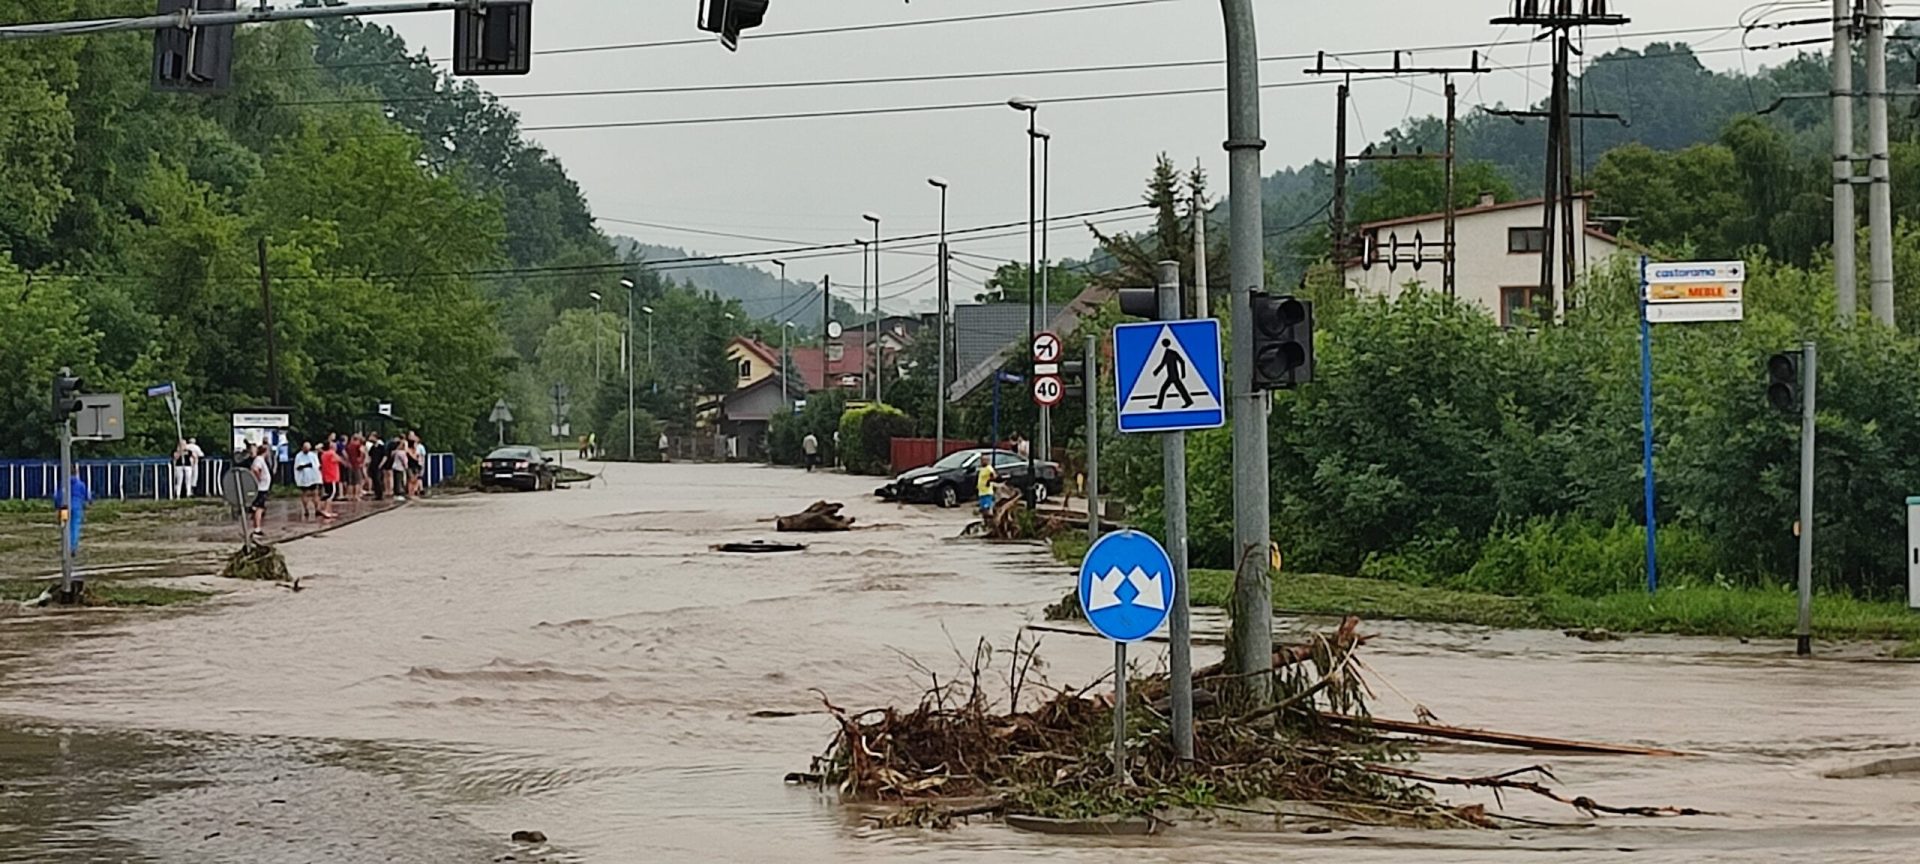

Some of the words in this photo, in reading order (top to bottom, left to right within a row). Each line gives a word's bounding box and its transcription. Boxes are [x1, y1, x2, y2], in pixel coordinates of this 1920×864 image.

[1655, 268, 1715, 278] castorama
[1688, 287, 1723, 297] MEBLE
[1037, 382, 1058, 397] 40
